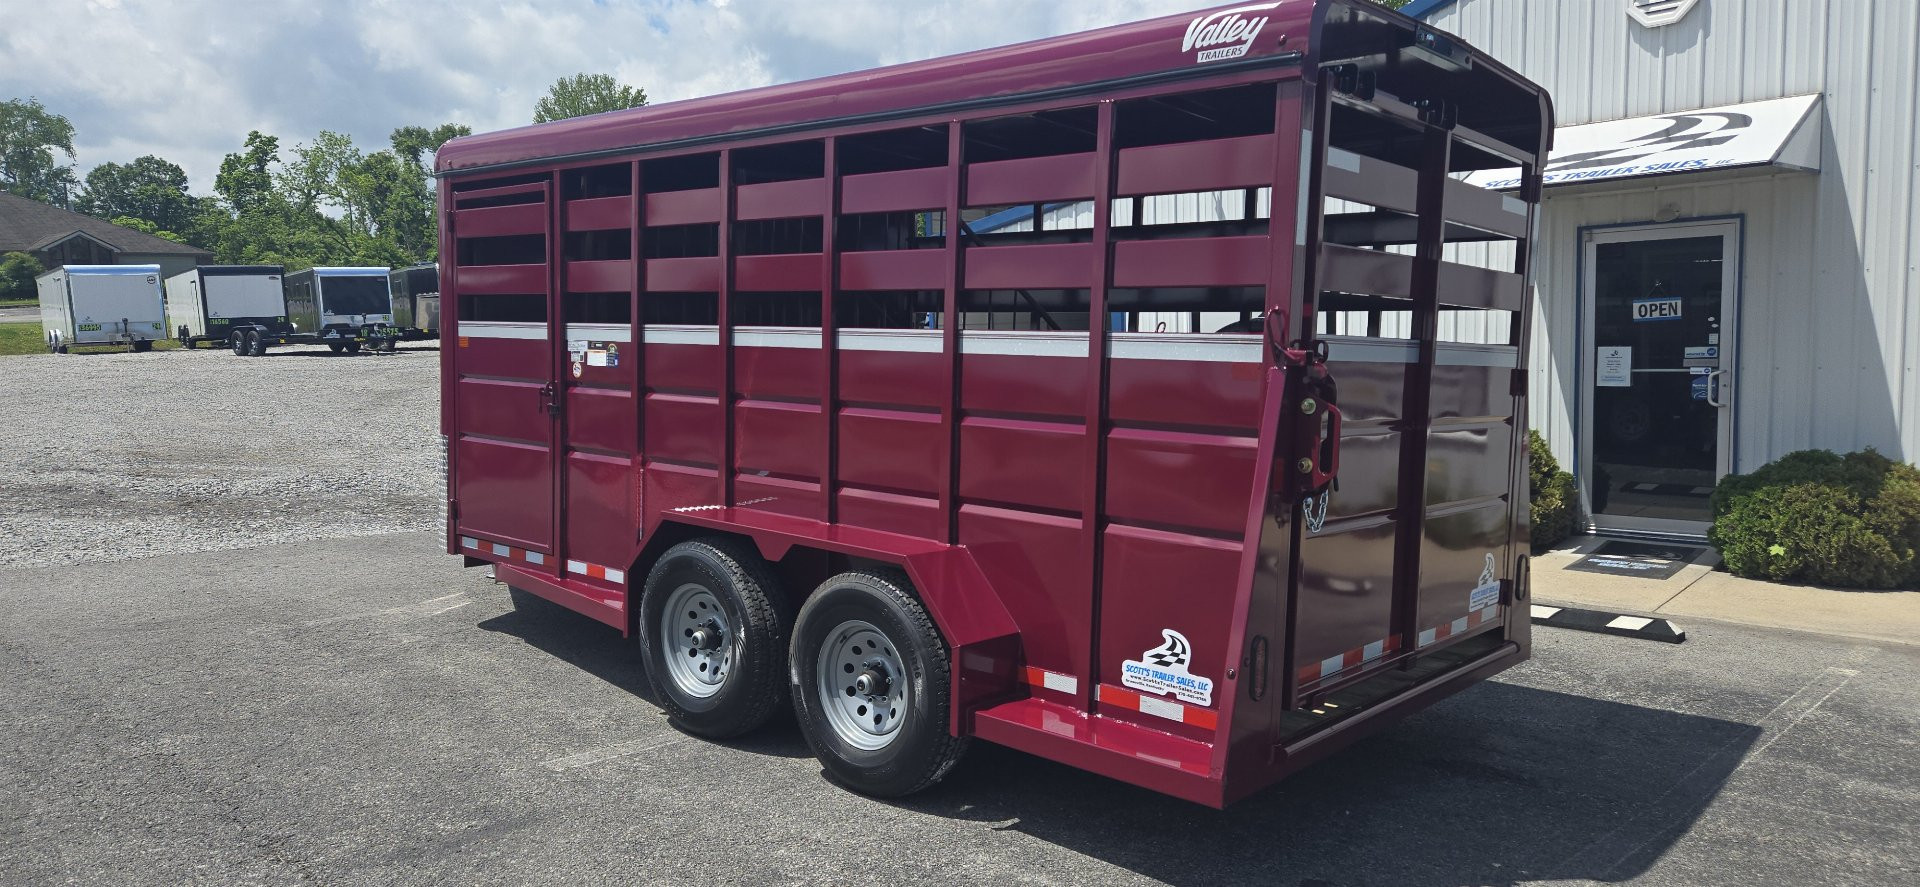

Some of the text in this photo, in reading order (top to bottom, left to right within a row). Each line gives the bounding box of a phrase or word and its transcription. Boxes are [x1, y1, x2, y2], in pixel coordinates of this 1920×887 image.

[1182, 4, 1277, 54] Valley
[1199, 46, 1243, 61] TRAILERS
[1561, 165, 1640, 181] TRAILER
[1638, 301, 1678, 318] OPEN
[1125, 664, 1209, 691] SCOTT'S TRAILER SALES, LLC
